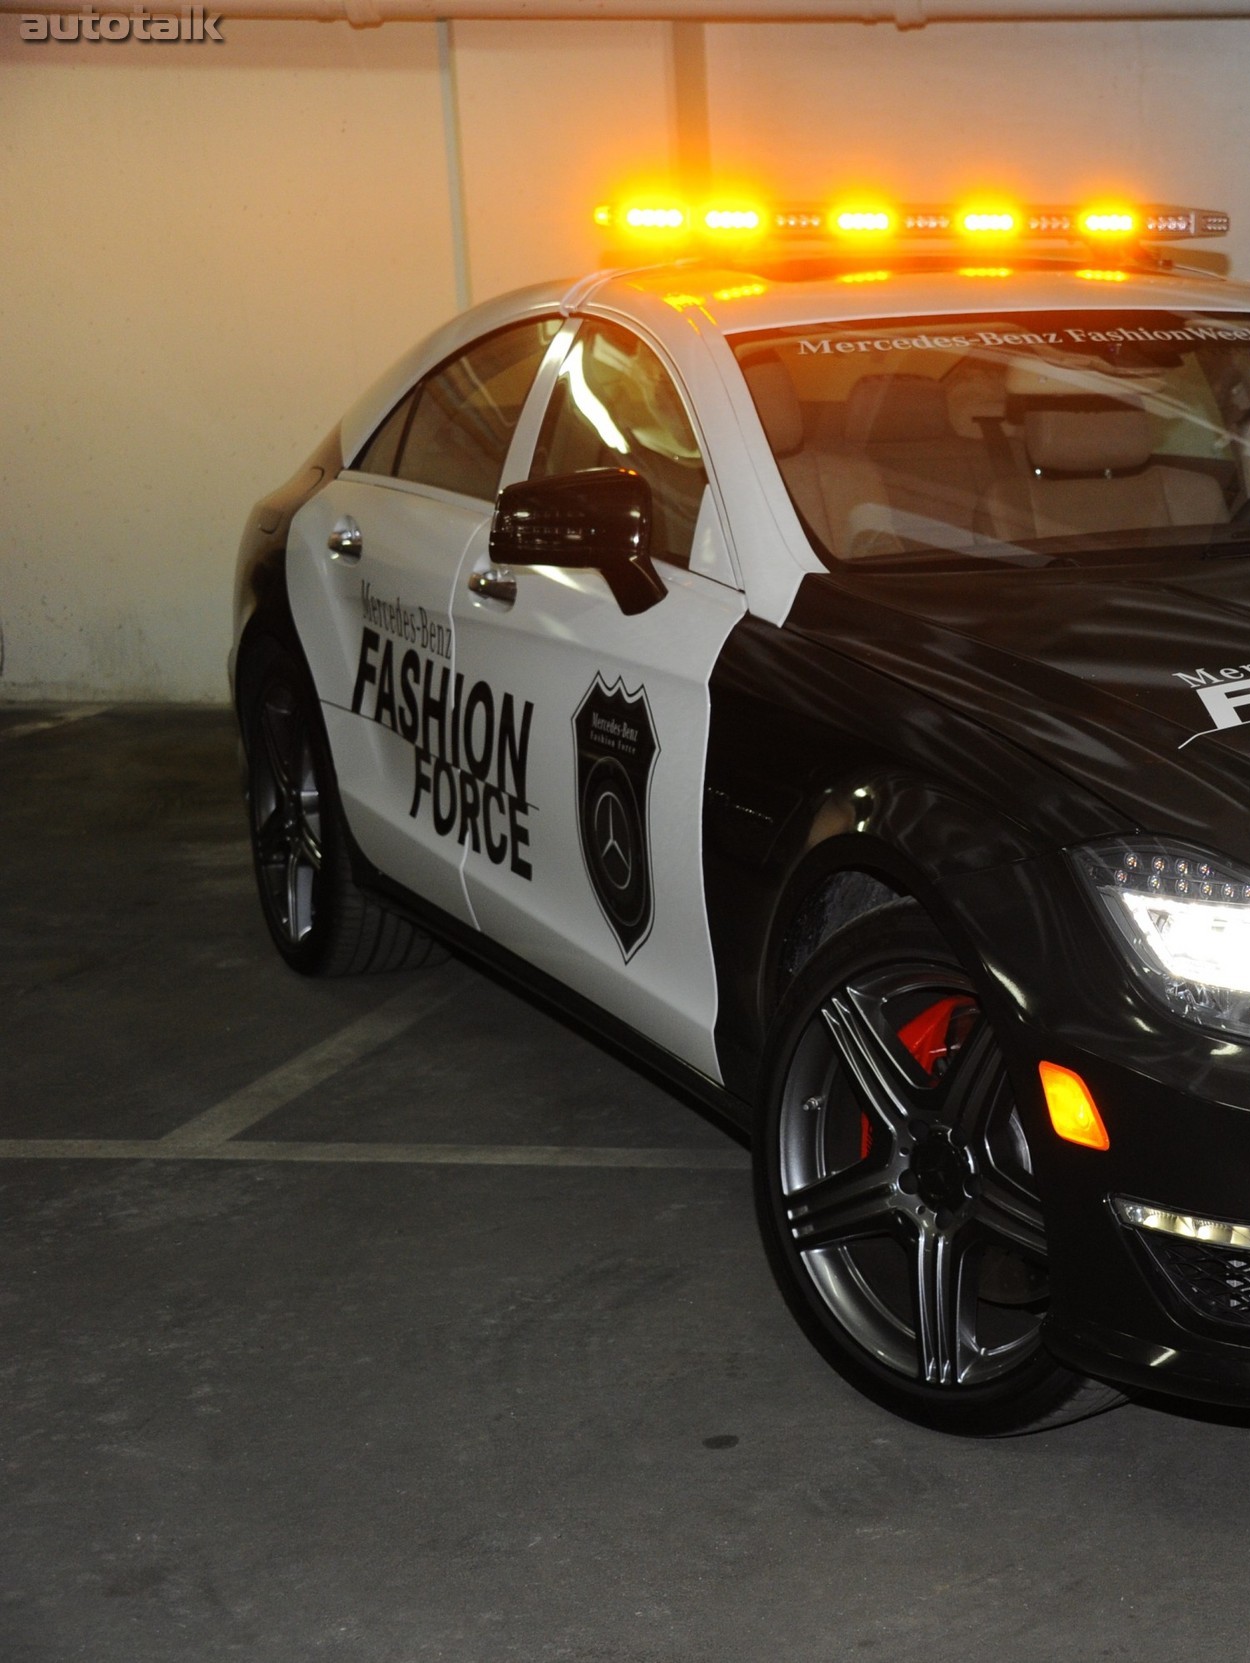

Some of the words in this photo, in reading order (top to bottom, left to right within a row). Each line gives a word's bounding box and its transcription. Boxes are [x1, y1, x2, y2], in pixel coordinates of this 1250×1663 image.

[797, 328, 1063, 356] Mercedes-Benz
[361, 579, 453, 660] Mercedes-Benz
[352, 626, 535, 804] FASHION
[591, 712, 639, 742] Mercedes-Benz
[409, 744, 533, 881] FORCE
